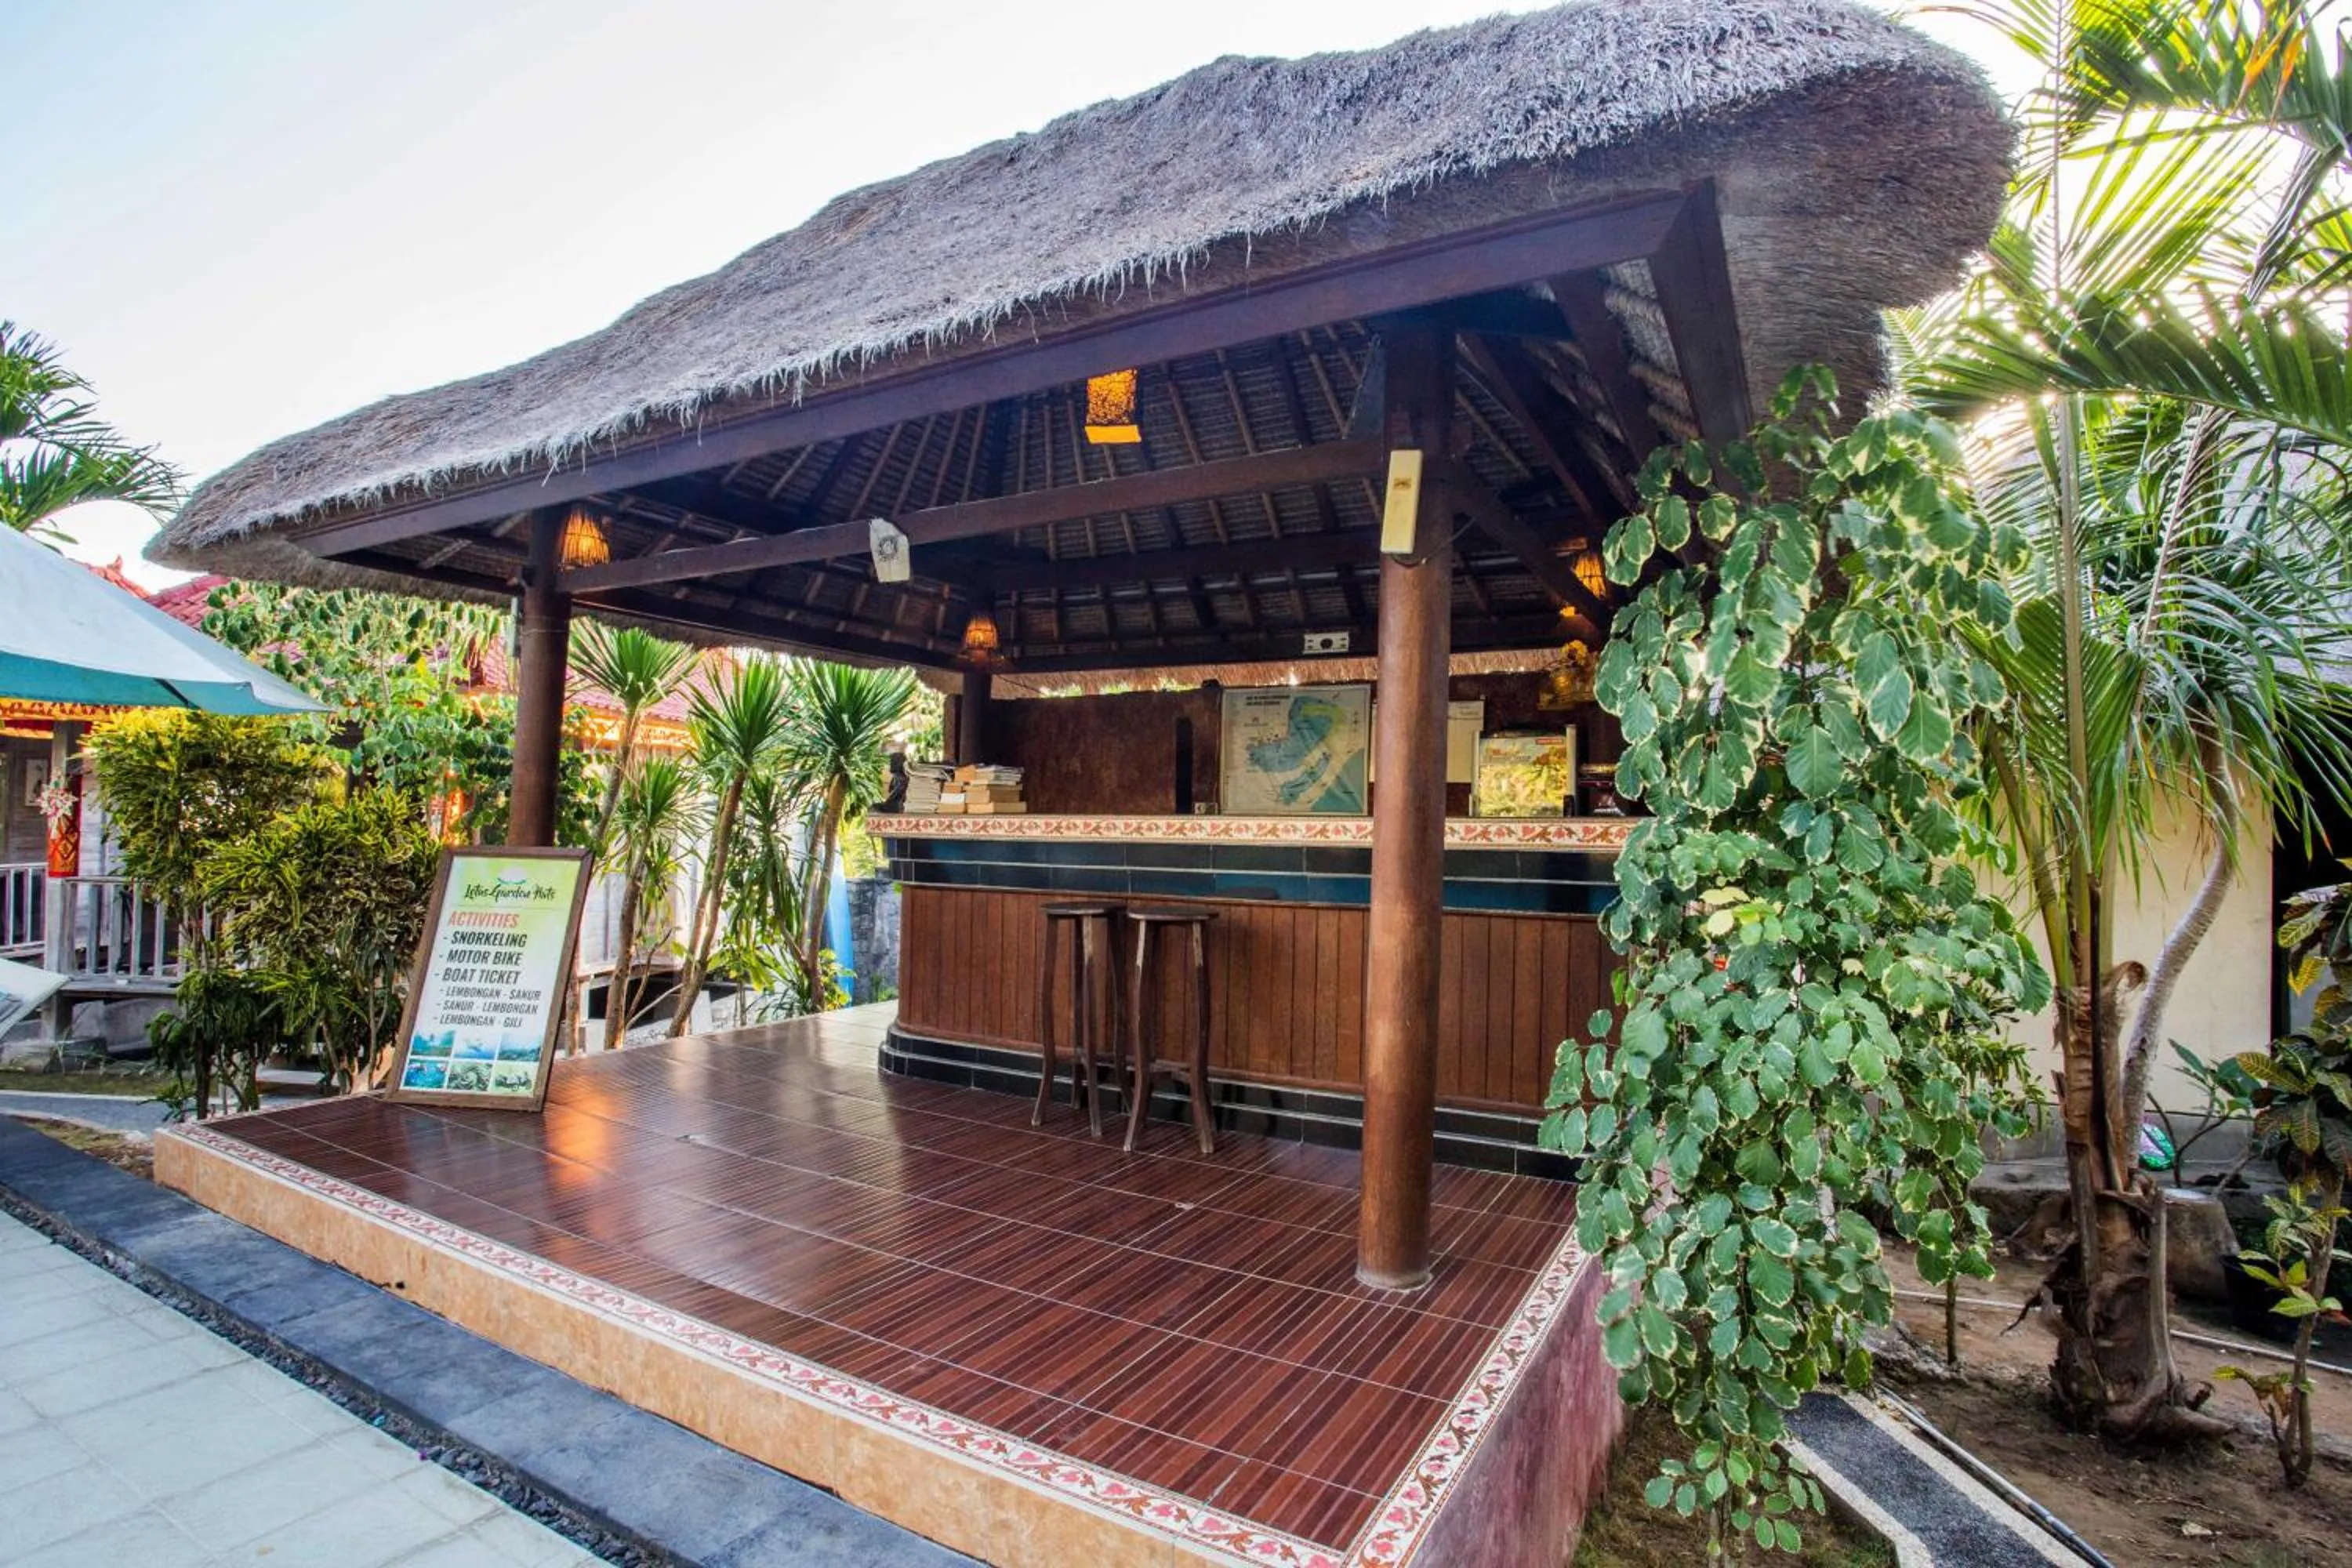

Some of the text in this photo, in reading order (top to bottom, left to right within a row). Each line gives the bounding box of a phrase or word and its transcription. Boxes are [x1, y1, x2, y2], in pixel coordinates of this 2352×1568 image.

[448, 912, 520, 928] ACTIVITIES
[451, 931, 528, 948] SNORKELING
[447, 949, 524, 966] MOTOR BIKE
[442, 967, 522, 985] BOAT TICKET
[445, 987, 541, 1000] LEMBONGAN SANUR
[443, 1000, 539, 1014] SANUR LEMBONGAN
[439, 1014, 523, 1028] LEMBONGAN GILI
